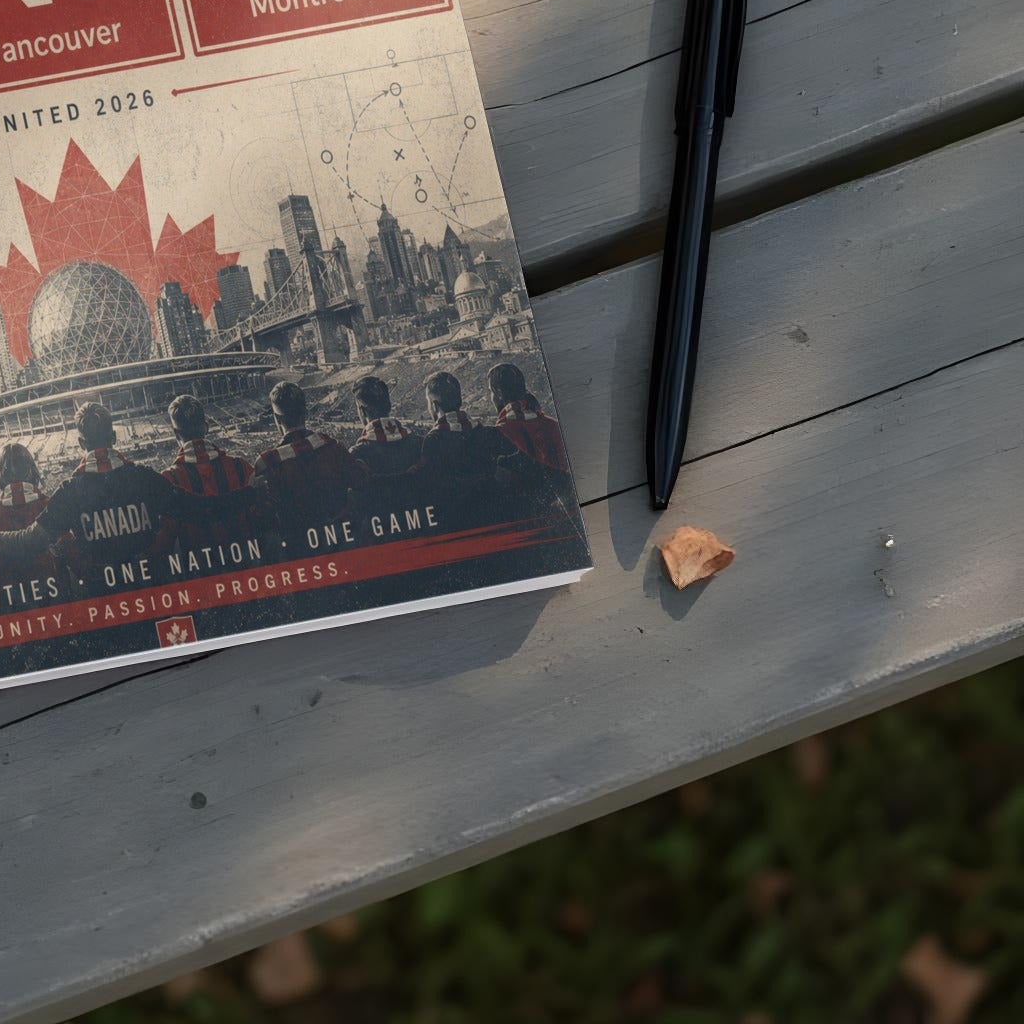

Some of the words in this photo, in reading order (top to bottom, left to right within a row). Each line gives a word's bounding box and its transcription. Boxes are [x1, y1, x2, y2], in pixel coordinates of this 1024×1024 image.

[94, 89, 155, 117] 2026
[80, 502, 152, 542] CANADA
[104, 559, 152, 588] ONE
[169, 538, 262, 575] NATION
[307, 522, 354, 549] ONE
[372, 506, 438, 537] GAME
[88, 589, 201, 622] PASSION.
[215, 564, 349, 598] PROGRESS.
